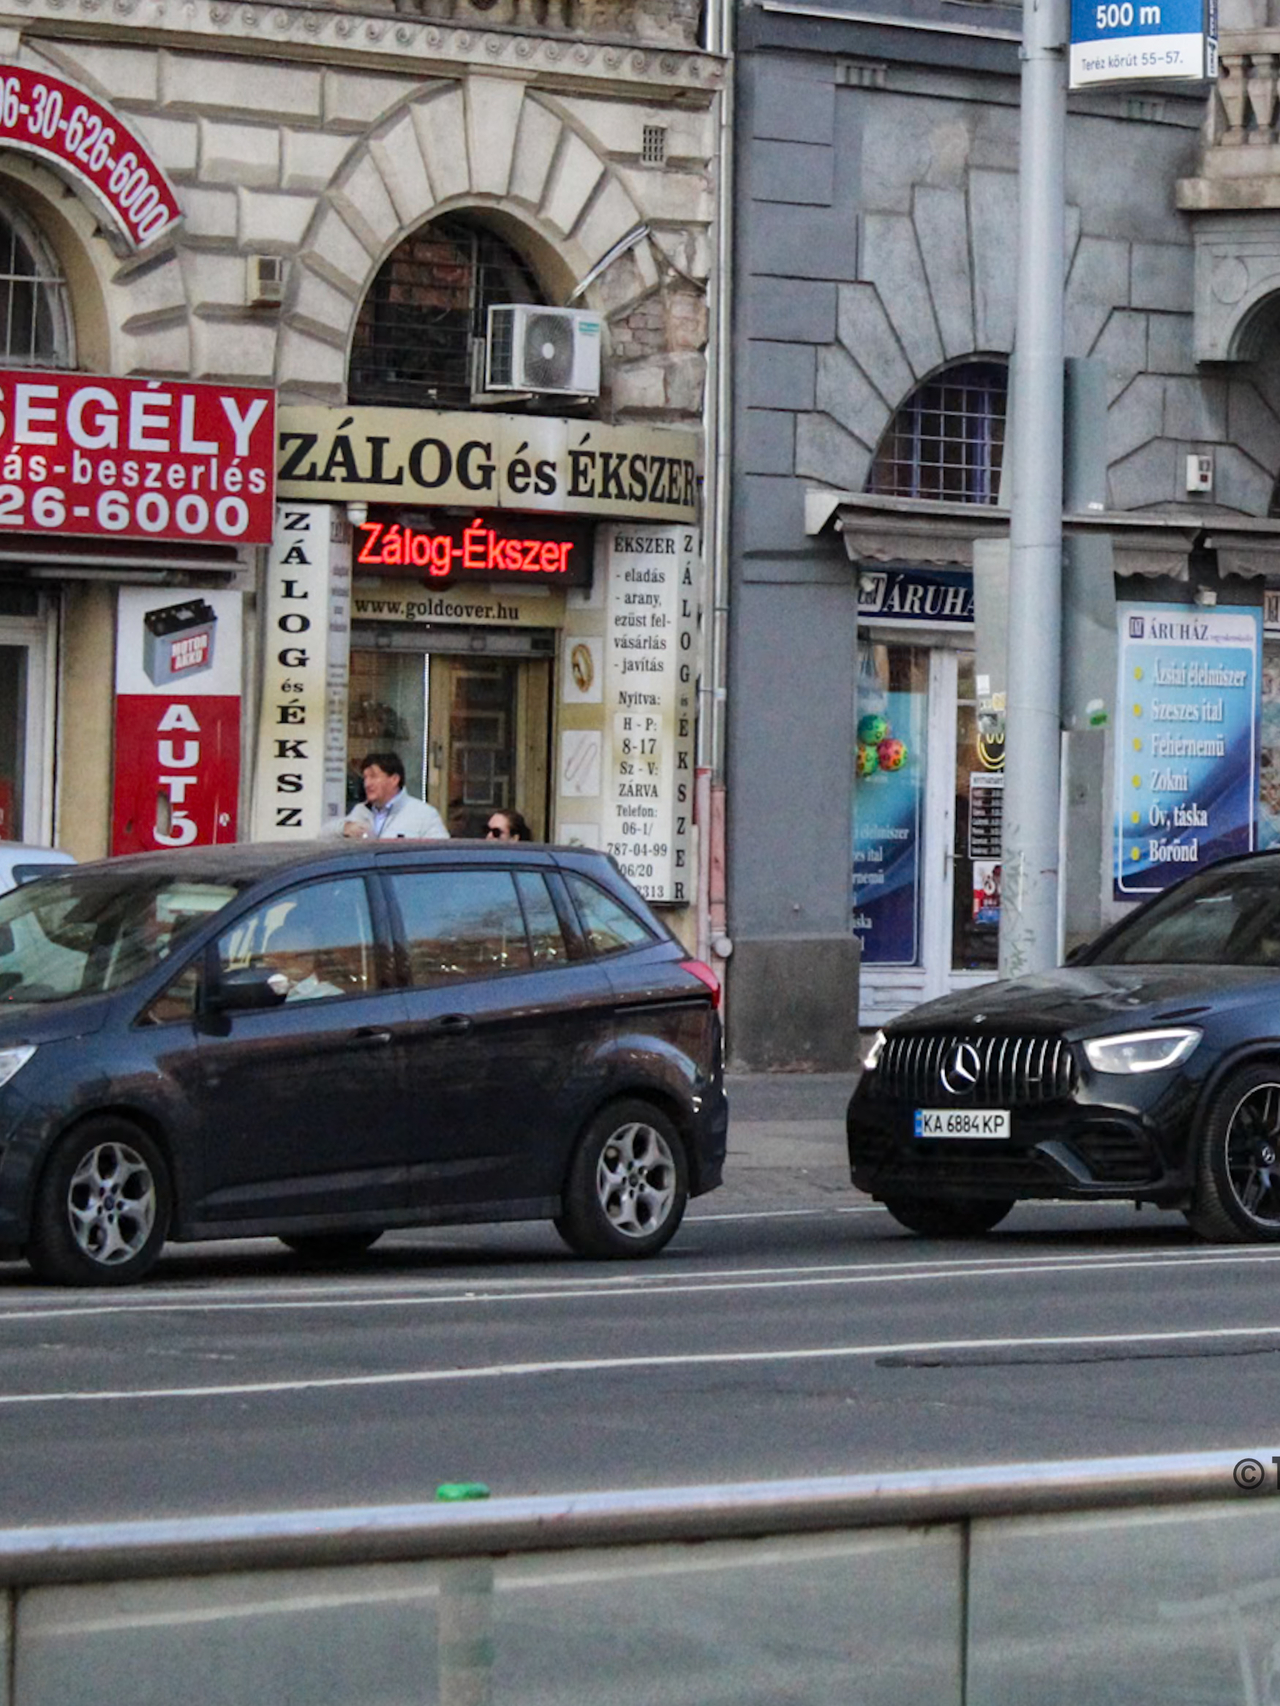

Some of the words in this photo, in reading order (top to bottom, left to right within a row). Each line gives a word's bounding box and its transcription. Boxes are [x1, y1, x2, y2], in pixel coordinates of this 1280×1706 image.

[1096, 2, 1134, 29] 500
[1140, 4, 1161, 26] m
[1082, 57, 1106, 72] Teréz
[278, 417, 497, 492] ZÁLOG
[507, 441, 557, 496] és
[567, 433, 695, 508] ÉKSZER
[358, 518, 574, 577] Zálog-Ékszer
[614, 534, 676, 555] ÉKSZER
[624, 568, 666, 584] eladás
[278, 512, 312, 668] ZÁLOG
[624, 592, 662, 608] arany,
[355, 598, 520, 622] www.goldcover.hu
[679, 535, 692, 684] ZÁLOG
[614, 613, 647, 628] ezüst
[651, 613, 672, 628] fel-
[1148, 617, 1209, 641] ÁRUHÁZ
[172, 634, 208, 658] MOTOR
[613, 634, 667, 651] vásárlás
[621, 657, 664, 674] javítás
[1188, 661, 1247, 687] élelmiszer
[281, 679, 304, 694] és
[618, 690, 661, 708] Nyitva:
[1151, 698, 1199, 722] Szeszes
[1201, 698, 1224, 722] ital
[623, 717, 633, 732] H
[644, 717, 657, 733] P:
[622, 738, 656, 756] 8-17
[153, 703, 201, 847] AUTÓ
[619, 761, 634, 776] Sz
[647, 761, 658, 776] V:
[618, 779, 659, 798] ZÁRVA
[1150, 768, 1188, 792] Zokni
[616, 804, 658, 818] Telefon:
[674, 715, 688, 900] ÉKSZER
[1173, 802, 1209, 827] táska
[622, 821, 654, 837] 06-1/
[607, 843, 668, 857] 787-04-99
[1149, 838, 1199, 862] Bőrönd
[620, 863, 653, 878] 06/20
[923, 1114, 944, 1133] KA
[946, 1114, 980, 1134] 6884
[983, 1114, 1005, 1133] KP
